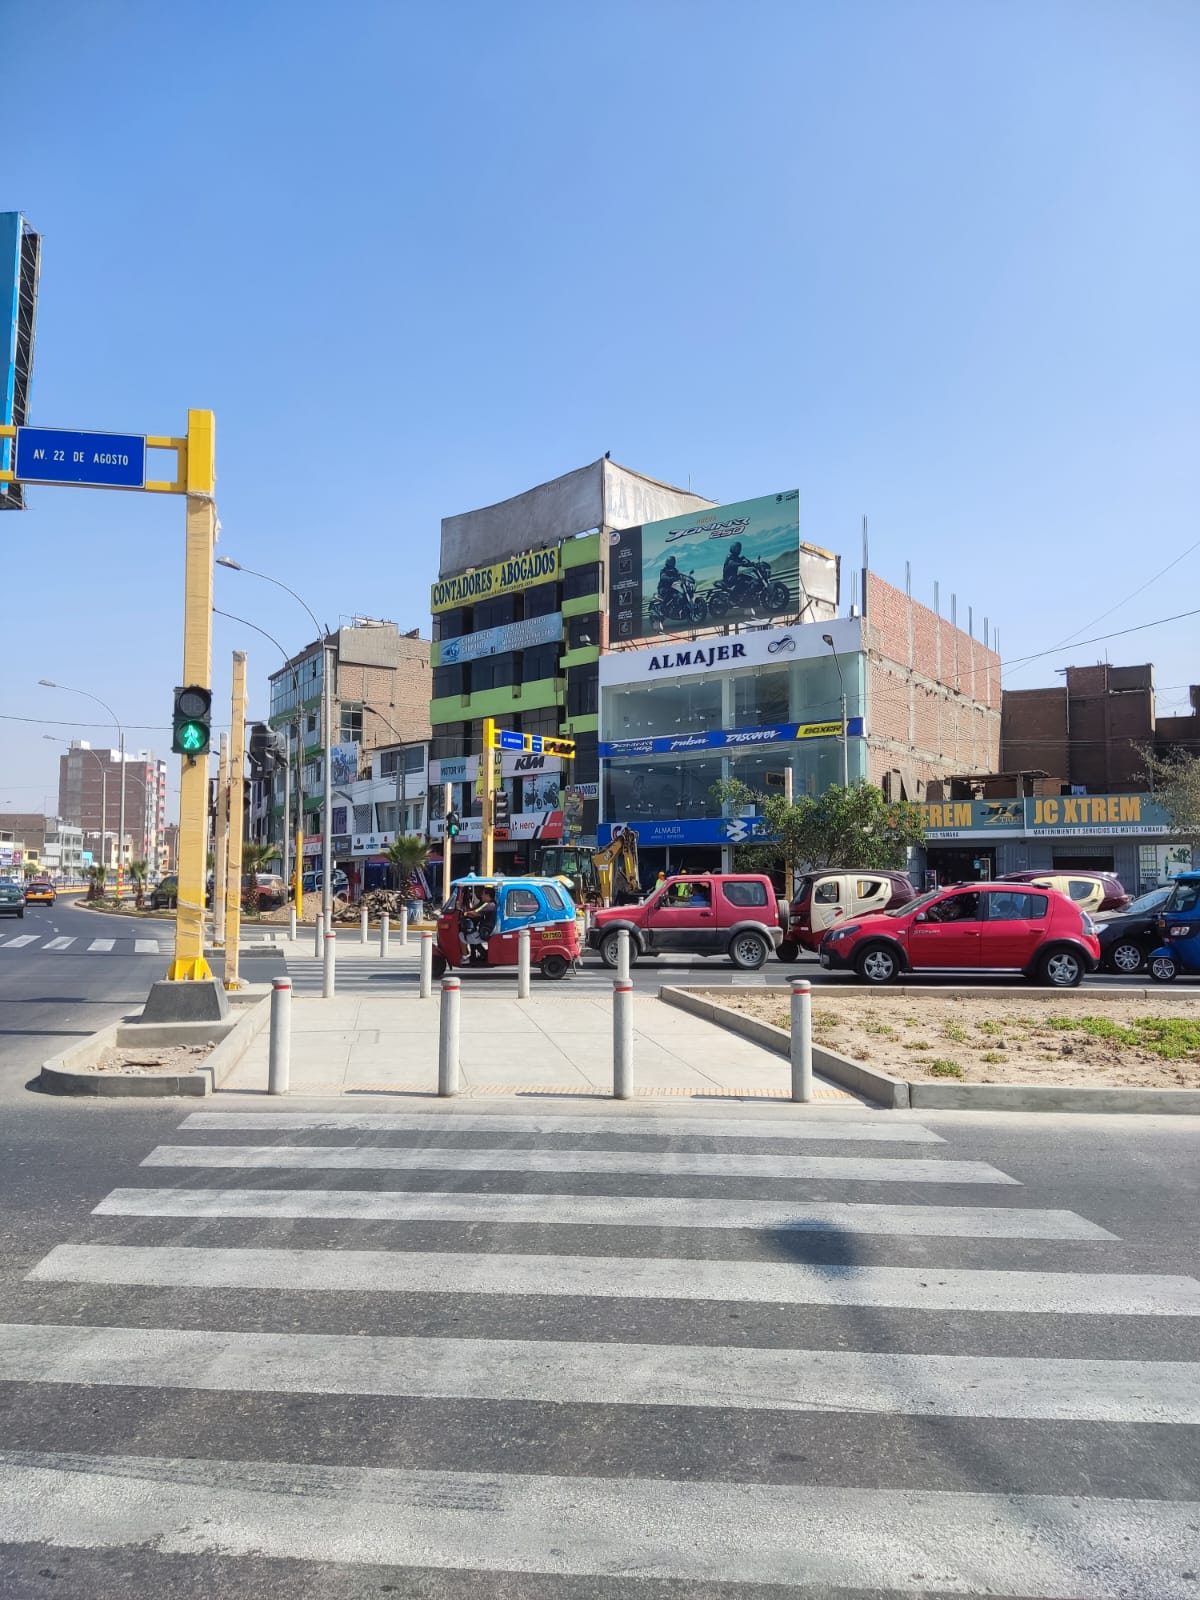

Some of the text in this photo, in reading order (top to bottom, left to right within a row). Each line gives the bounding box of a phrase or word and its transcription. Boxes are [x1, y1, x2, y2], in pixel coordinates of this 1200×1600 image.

[33, 449, 129, 466] AV. 22 DE AGOSTO
[709, 526, 746, 539] 250
[433, 569, 492, 606] CONTADORES
[499, 549, 555, 588] ABOGADOS
[648, 643, 747, 671] ALMAJER
[514, 754, 545, 771] KTM
[1034, 796, 1142, 825] JC XTREM
[654, 826, 681, 834] ALMAJER
